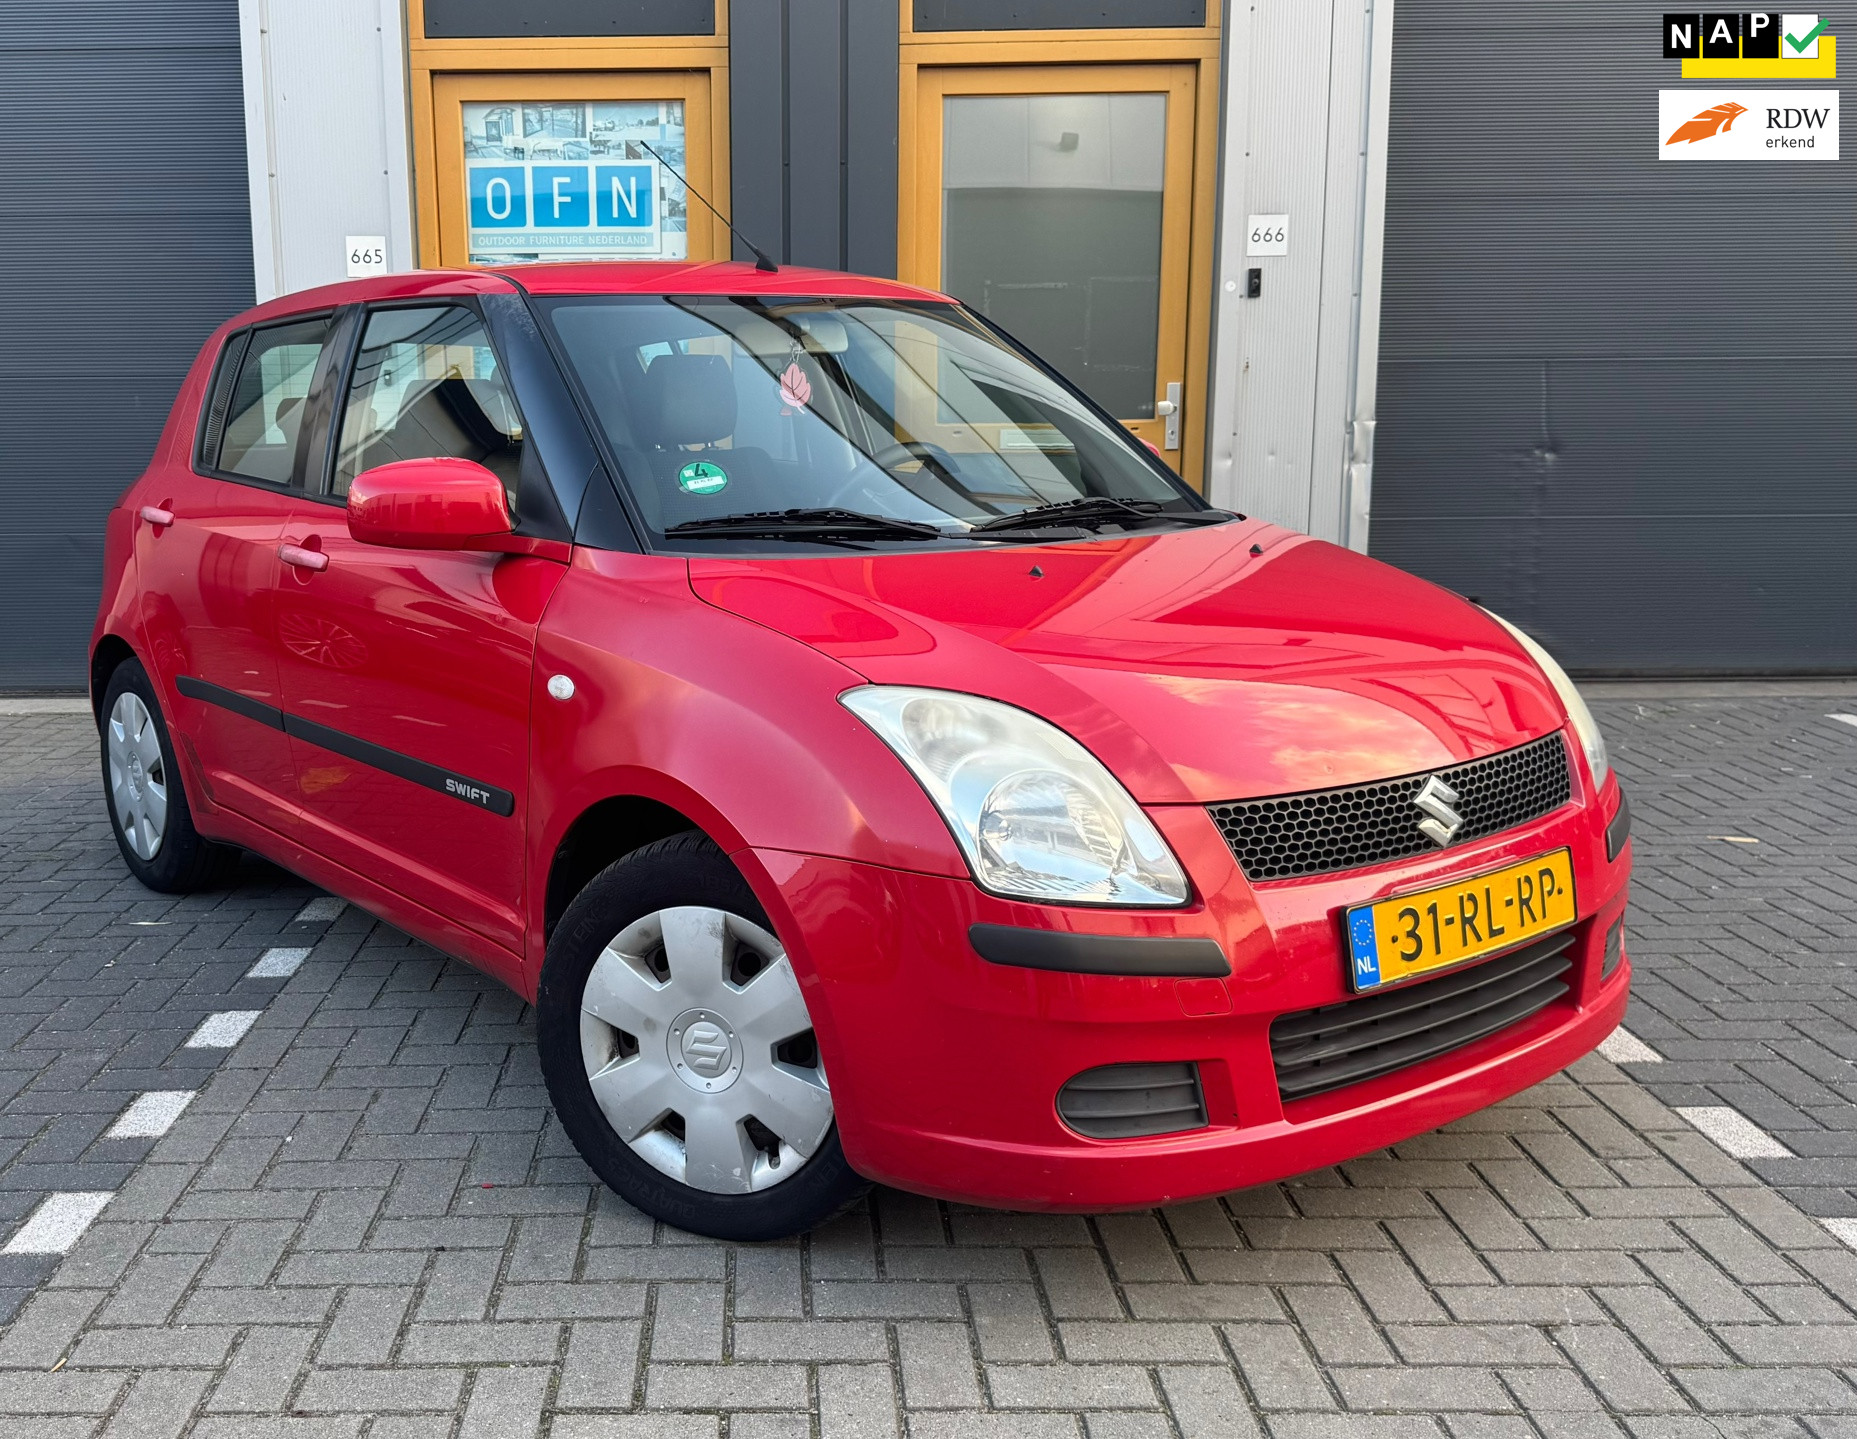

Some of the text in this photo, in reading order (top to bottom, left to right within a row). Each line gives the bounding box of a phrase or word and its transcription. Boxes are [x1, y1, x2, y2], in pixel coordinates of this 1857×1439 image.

[478, 235, 647, 246] OUTDOOR FURNITURE NEDERLAND
[1251, 227, 1285, 243] 666
[351, 248, 383, 264] 665
[445, 778, 490, 804] SWIFT
[1357, 957, 1377, 976] NL
